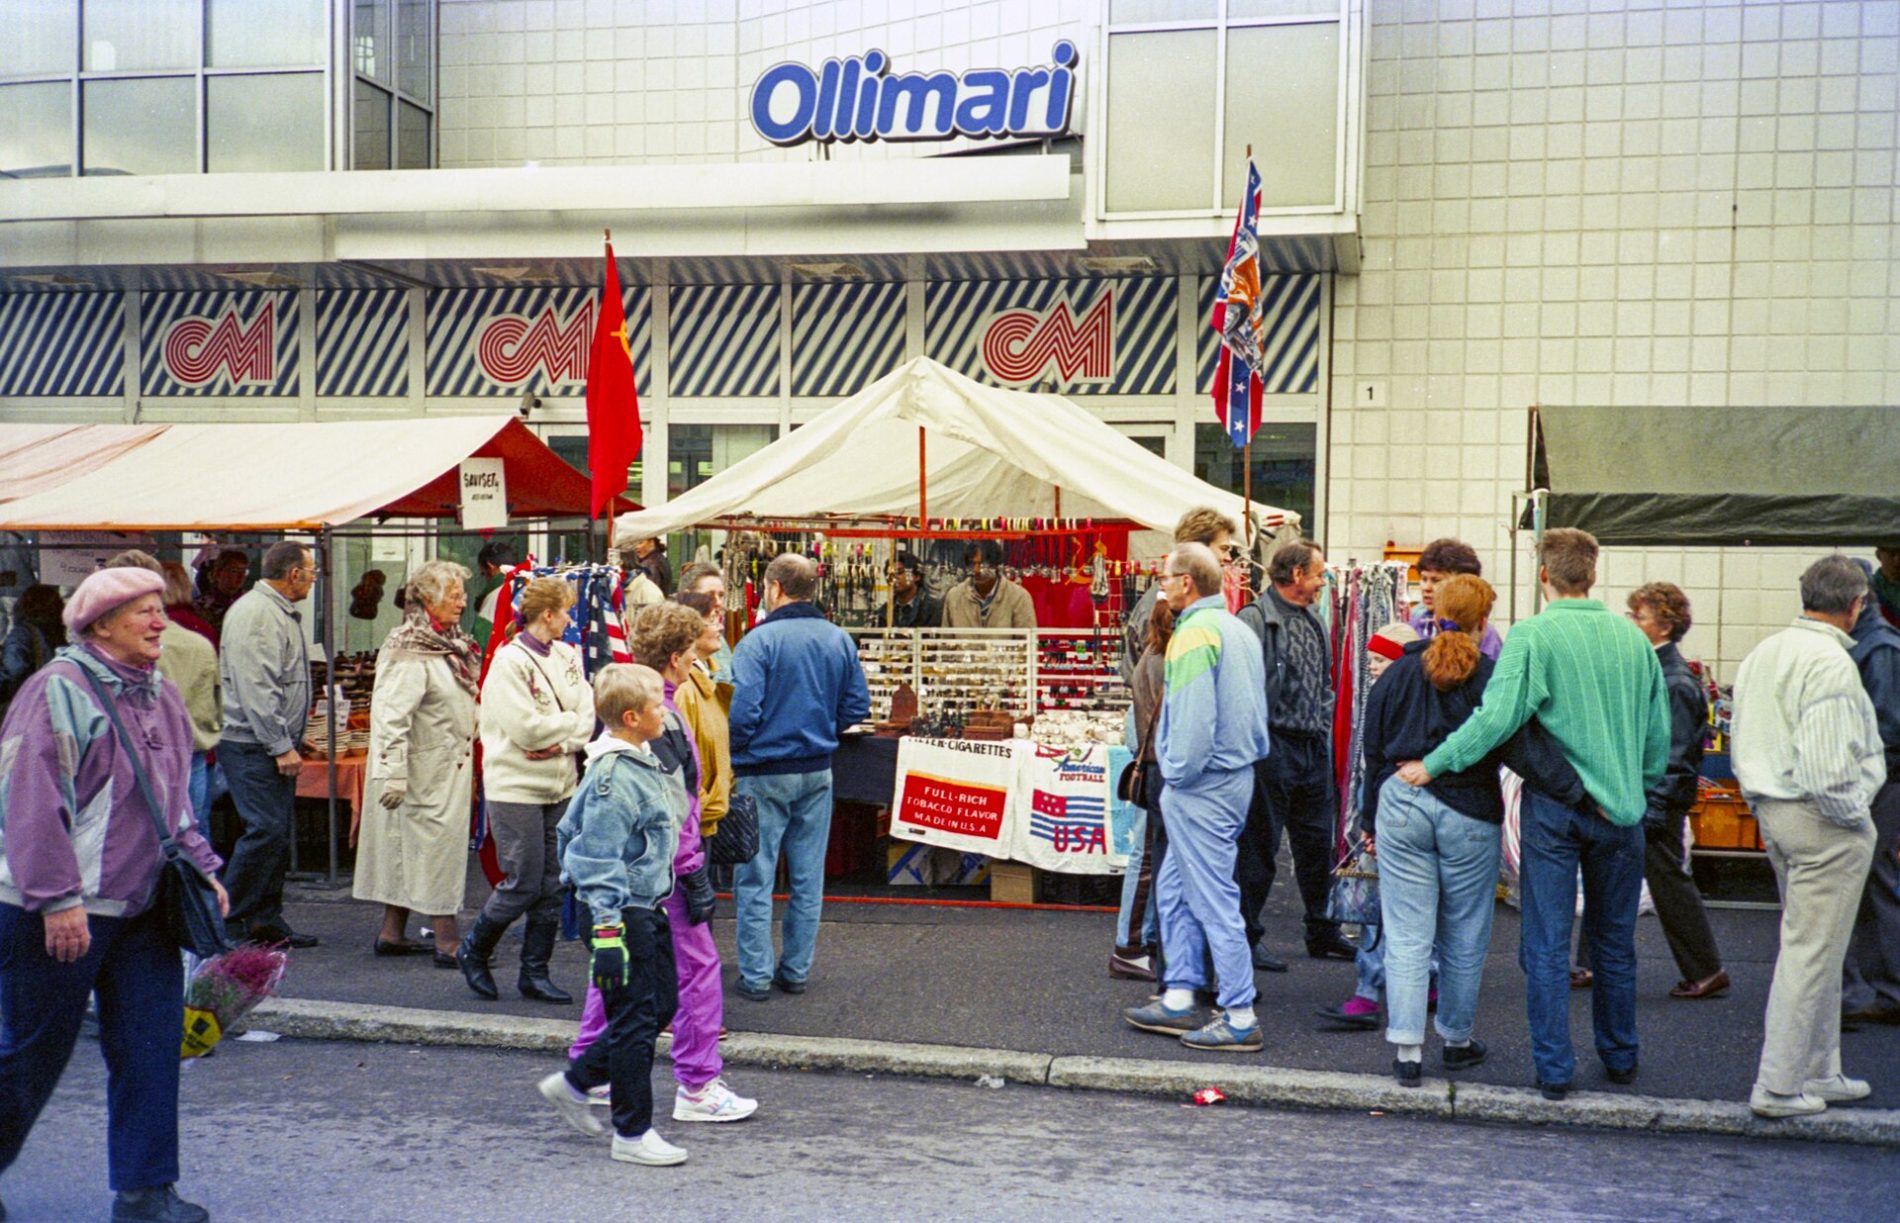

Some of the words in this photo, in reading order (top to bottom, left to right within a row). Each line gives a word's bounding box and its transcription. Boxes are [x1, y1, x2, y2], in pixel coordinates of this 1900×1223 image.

[751, 41, 1075, 141] Ollimari
[164, 299, 274, 386] CM
[982, 288, 1112, 384] CM
[1366, 386, 1373, 401] 1
[1059, 773, 1105, 783] FOOTBALL
[906, 796, 953, 814] TOBACCO
[957, 807, 998, 821] FLAVOR
[914, 812, 946, 826] MADE
[948, 820, 958, 829] IN
[1053, 825, 1107, 855] USA
